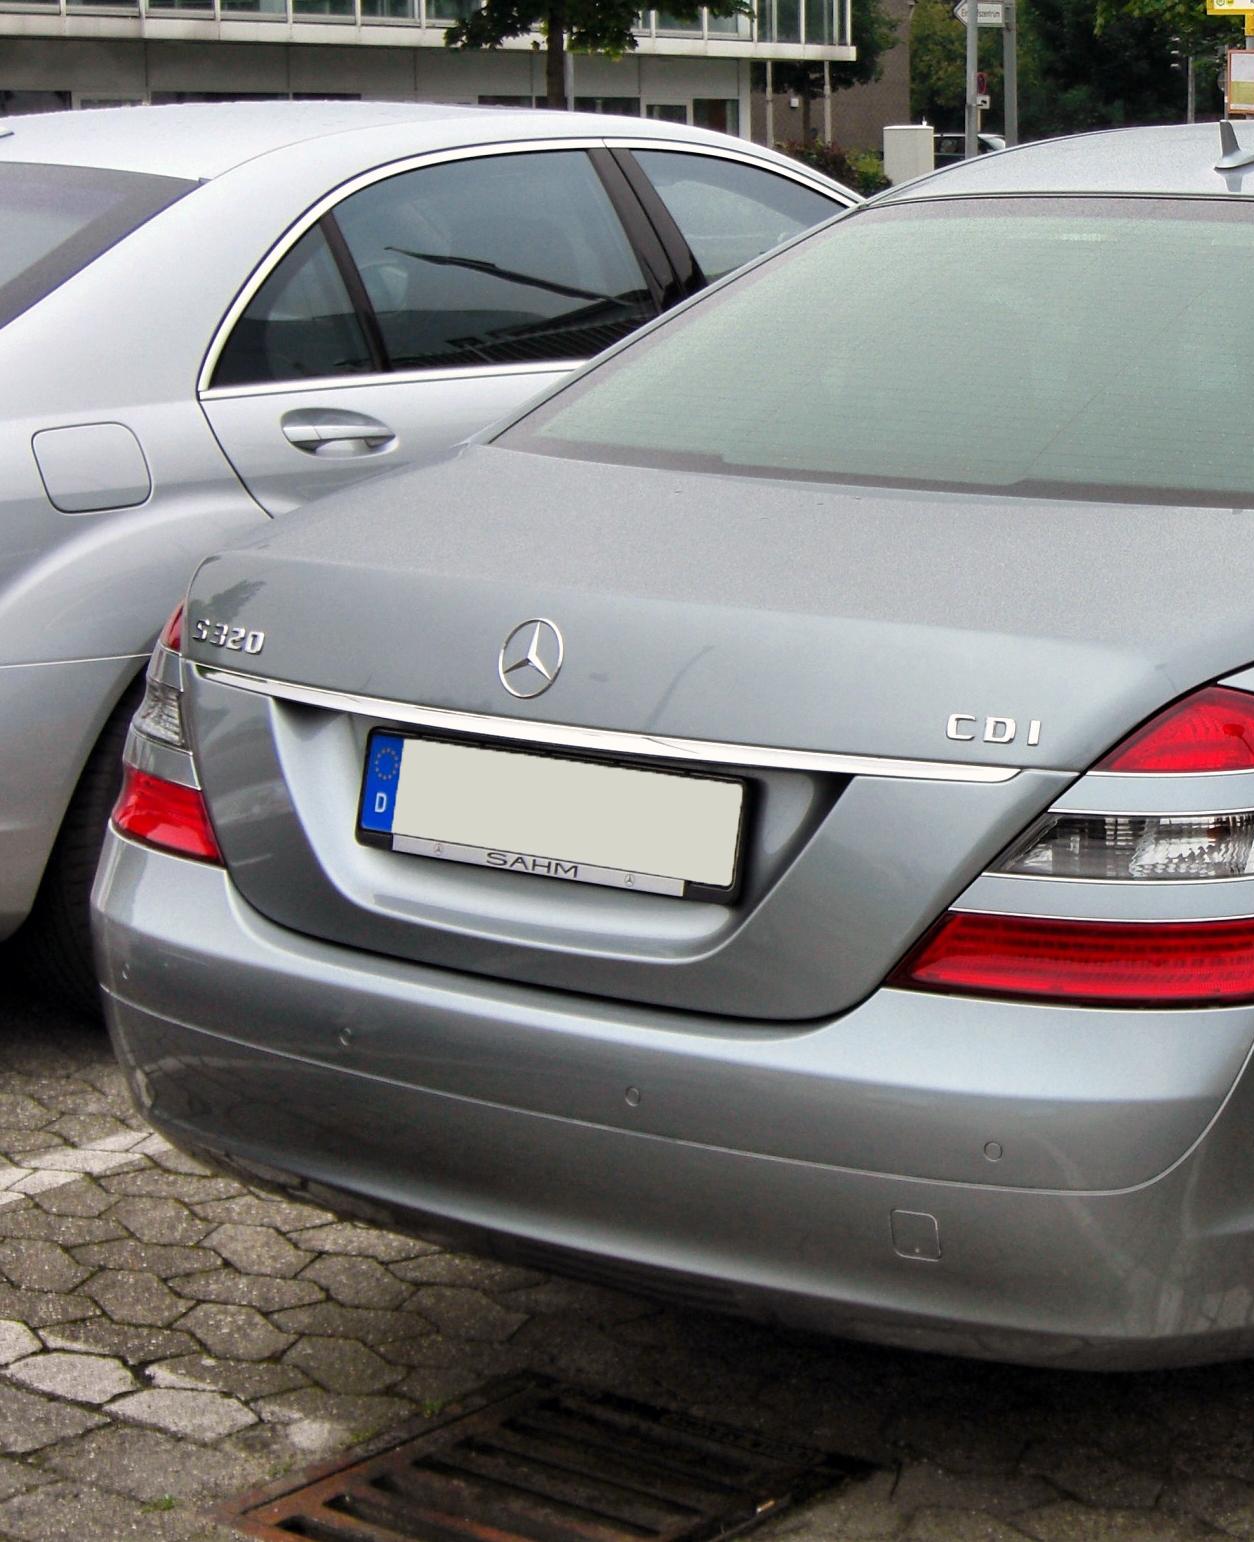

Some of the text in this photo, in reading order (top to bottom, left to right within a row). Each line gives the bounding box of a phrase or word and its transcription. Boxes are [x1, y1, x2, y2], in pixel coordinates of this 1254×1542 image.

[945, 713, 1041, 747] CDI
[375, 792, 389, 813] D
[485, 851, 579, 879] SAHM
